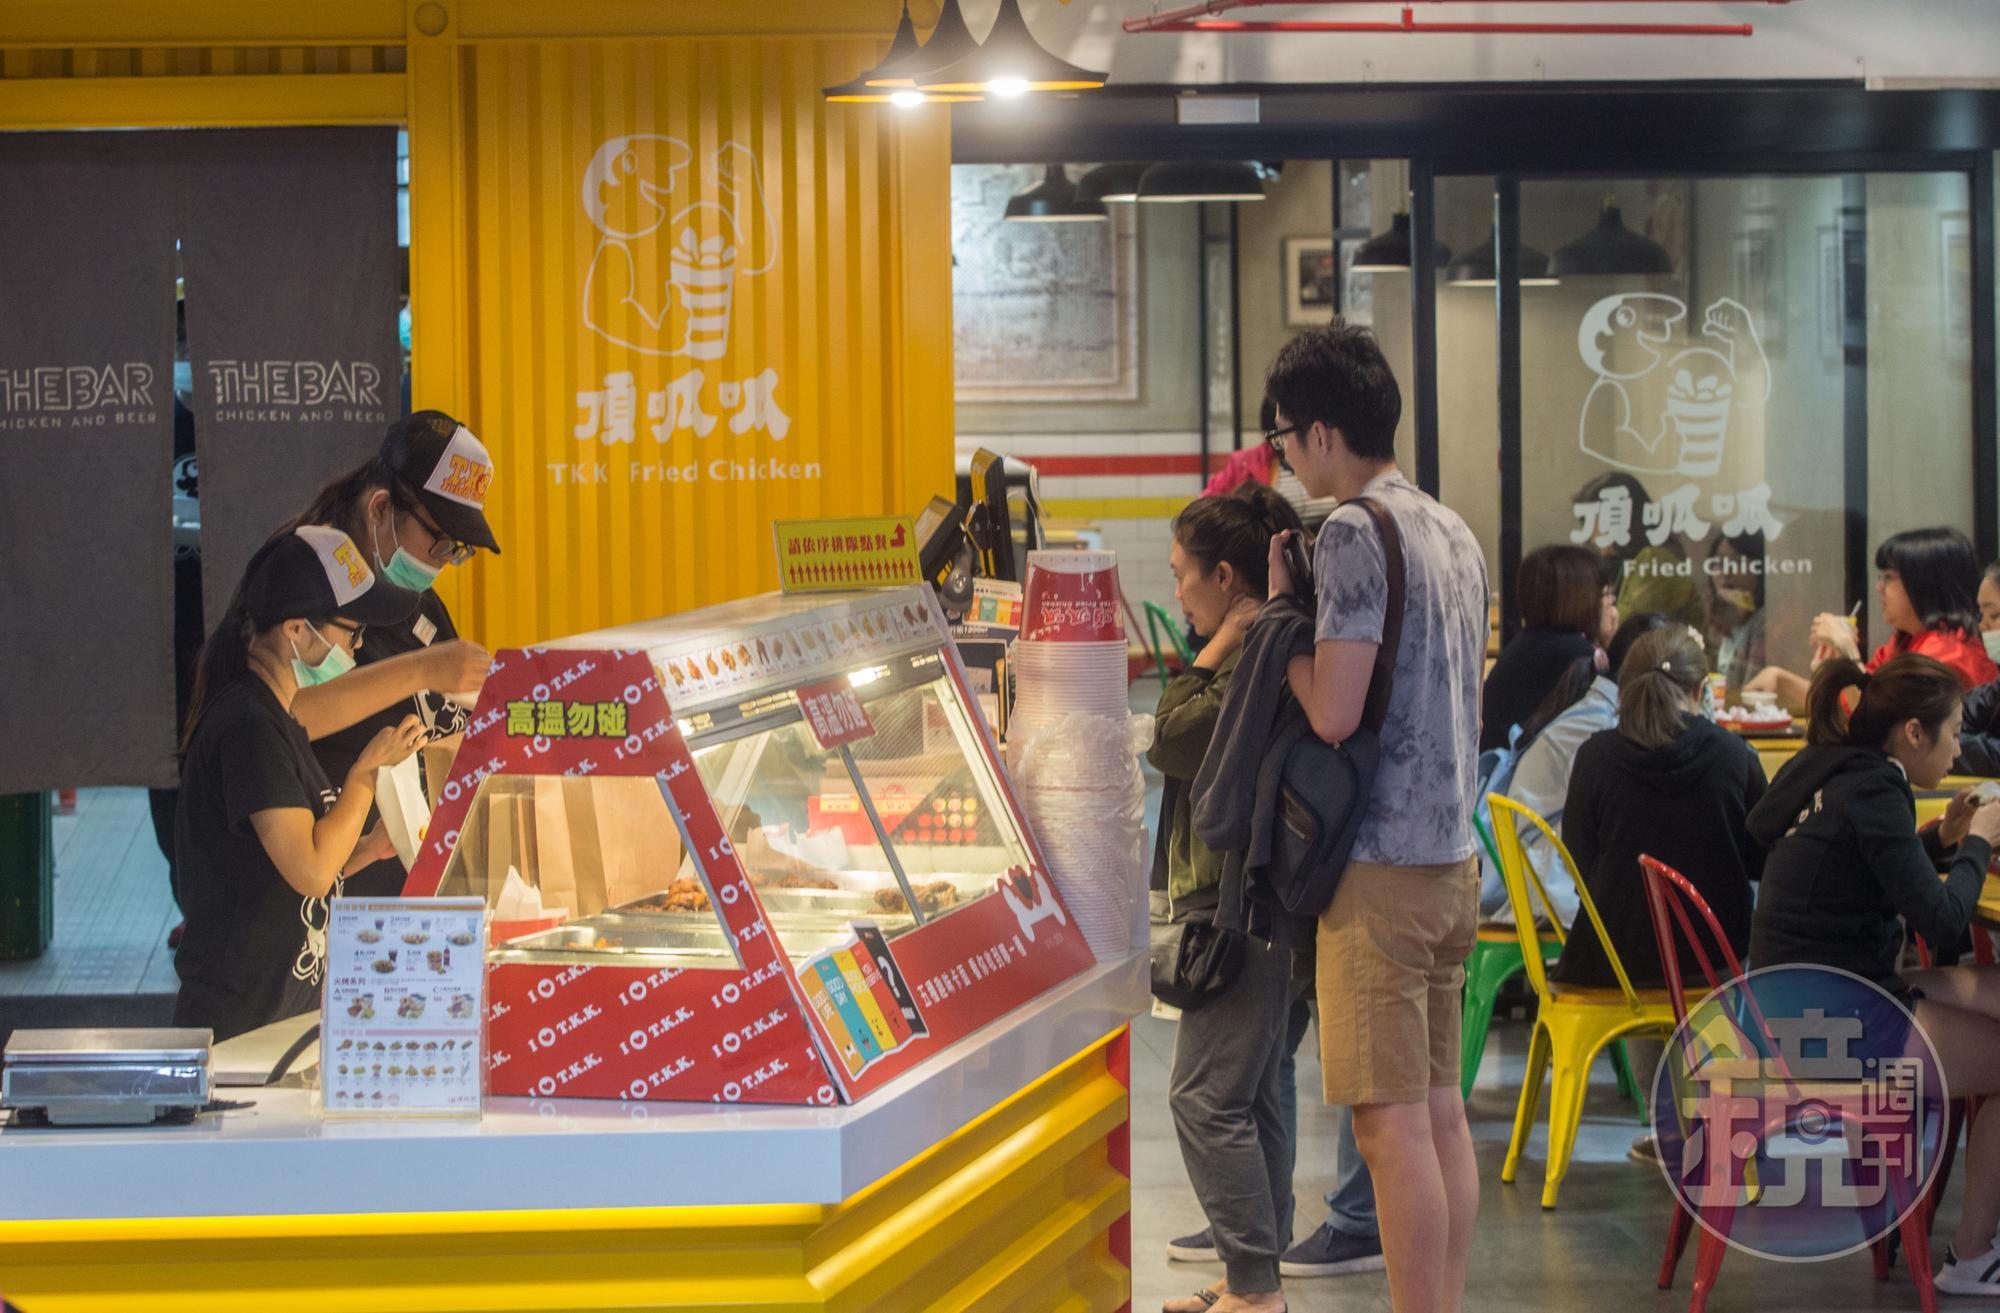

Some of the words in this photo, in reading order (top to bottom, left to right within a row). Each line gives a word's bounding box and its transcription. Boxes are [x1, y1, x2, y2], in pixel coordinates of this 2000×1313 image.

[0, 363, 154, 411] HEBAR
[208, 359, 382, 405] THEBAR
[0, 416, 62, 430] HICKEN
[71, 415, 106, 427] AND
[115, 412, 157, 425] BEER
[215, 409, 291, 423] CHICKEN
[299, 410, 334, 422] AND
[343, 410, 386, 423] BEER
[574, 368, 792, 445] 頂呱呱
[548, 463, 608, 485] TKK
[630, 459, 699, 482] Fried
[708, 457, 822, 481] Chicken
[1623, 557, 1692, 577] Fried
[1703, 555, 1813, 576] Chicken
[507, 701, 627, 737] 高溫勿碰
[740, 960, 784, 991] T.K.K
[556, 1003, 602, 1035] T.K.K.
[648, 1006, 695, 1038] T.K.K.
[741, 1008, 788, 1040] T.K.K.
[556, 1053, 602, 1084] T.K.K.
[649, 1056, 695, 1087] T.K.K.
[742, 1058, 789, 1089] T.K.K.
